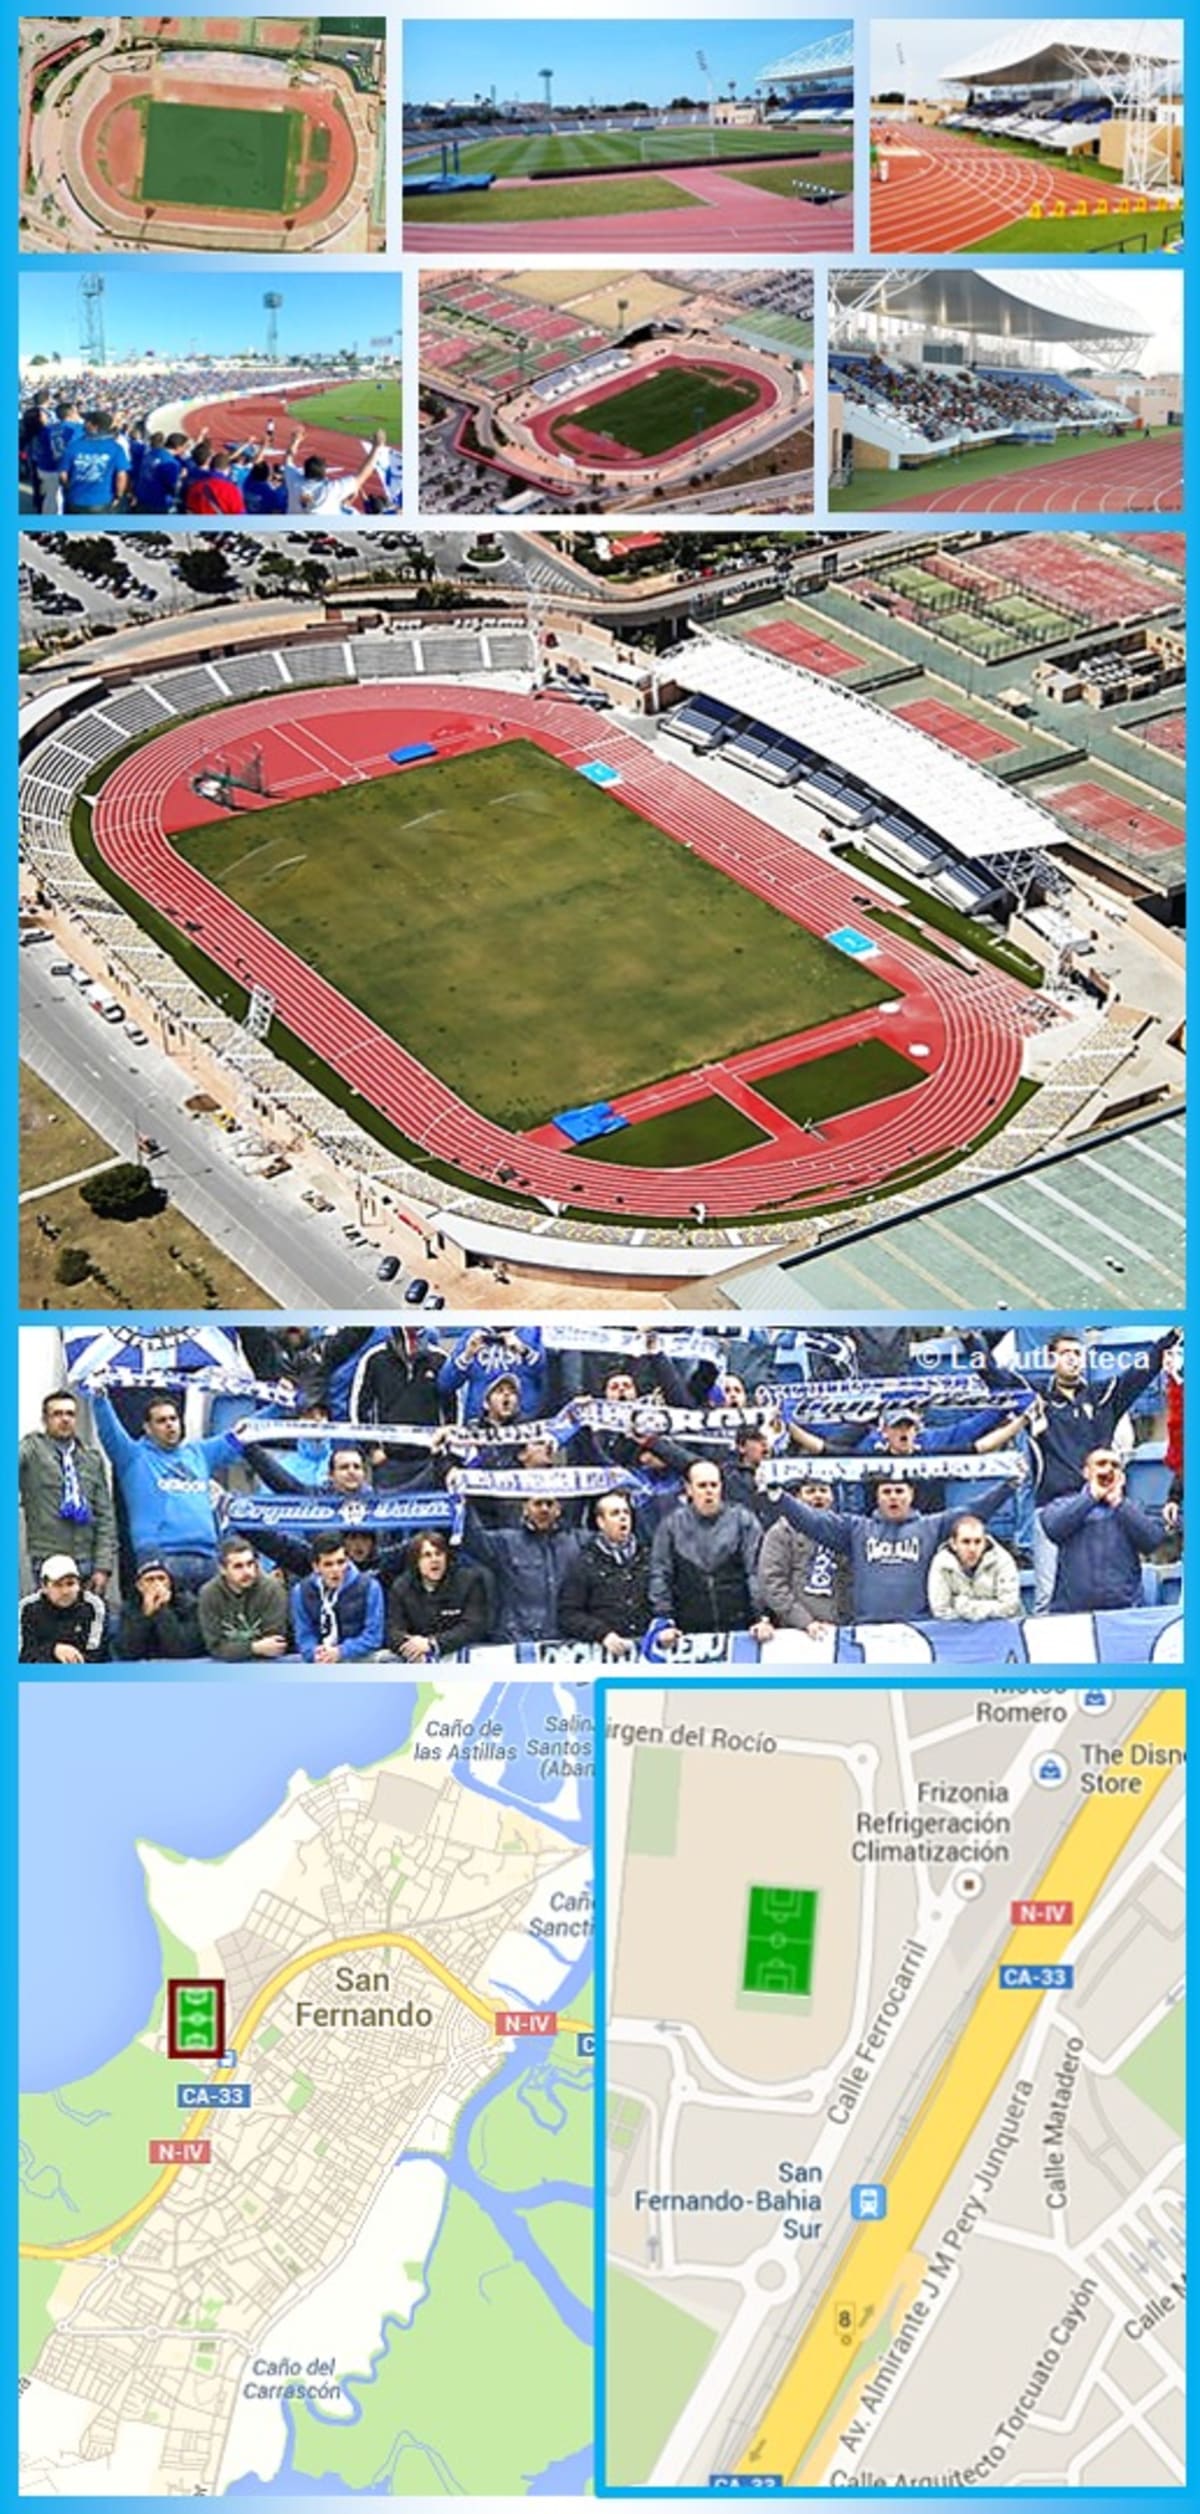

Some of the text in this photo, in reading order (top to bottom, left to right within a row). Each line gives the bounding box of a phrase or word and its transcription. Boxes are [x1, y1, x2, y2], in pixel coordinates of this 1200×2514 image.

[976, 1702, 1068, 1722] Romero
[425, 1719, 503, 1737] Caño de
[545, 1714, 596, 1733] Salin
[527, 1738, 592, 1757] Santos
[669, 1723, 705, 1747] del
[711, 1727, 778, 1753] Rocío
[414, 1742, 518, 1761] las Astillas
[1080, 1743, 1187, 1765] The Disn
[917, 1780, 1009, 1803] Frizonia
[1080, 1772, 1142, 1794] Store
[857, 1810, 1011, 1838] Refrigeración
[851, 1839, 1009, 1863] Climatización
[549, 1890, 595, 1912] Cañ
[1020, 1905, 1067, 1923] N-IV
[335, 1966, 390, 1993] San
[1003, 1967, 1067, 1986] CA-33
[296, 2000, 433, 2028] Fernando
[504, 2015, 550, 2033] N-IV
[827, 1938, 928, 2125] Calle Ferrocarril
[182, 2087, 244, 2104] CA-33
[1042, 2036, 1085, 2210] Calle Matadero
[159, 2143, 204, 2161] N-IV
[778, 2162, 822, 2184] San
[634, 2189, 822, 2212] Fernando-Bahia
[783, 2218, 822, 2240] Sur
[839, 2079, 1035, 2454] Av. Almirante J M Pery Junquera
[838, 2310, 851, 2329] 8
[1124, 2295, 1176, 2341] Calle
[252, 2357, 336, 2376] Caño del
[994, 2347, 1061, 2444] Torcuato
[1049, 2276, 1099, 2347] Cayón
[243, 2380, 341, 2400] Carrascón
